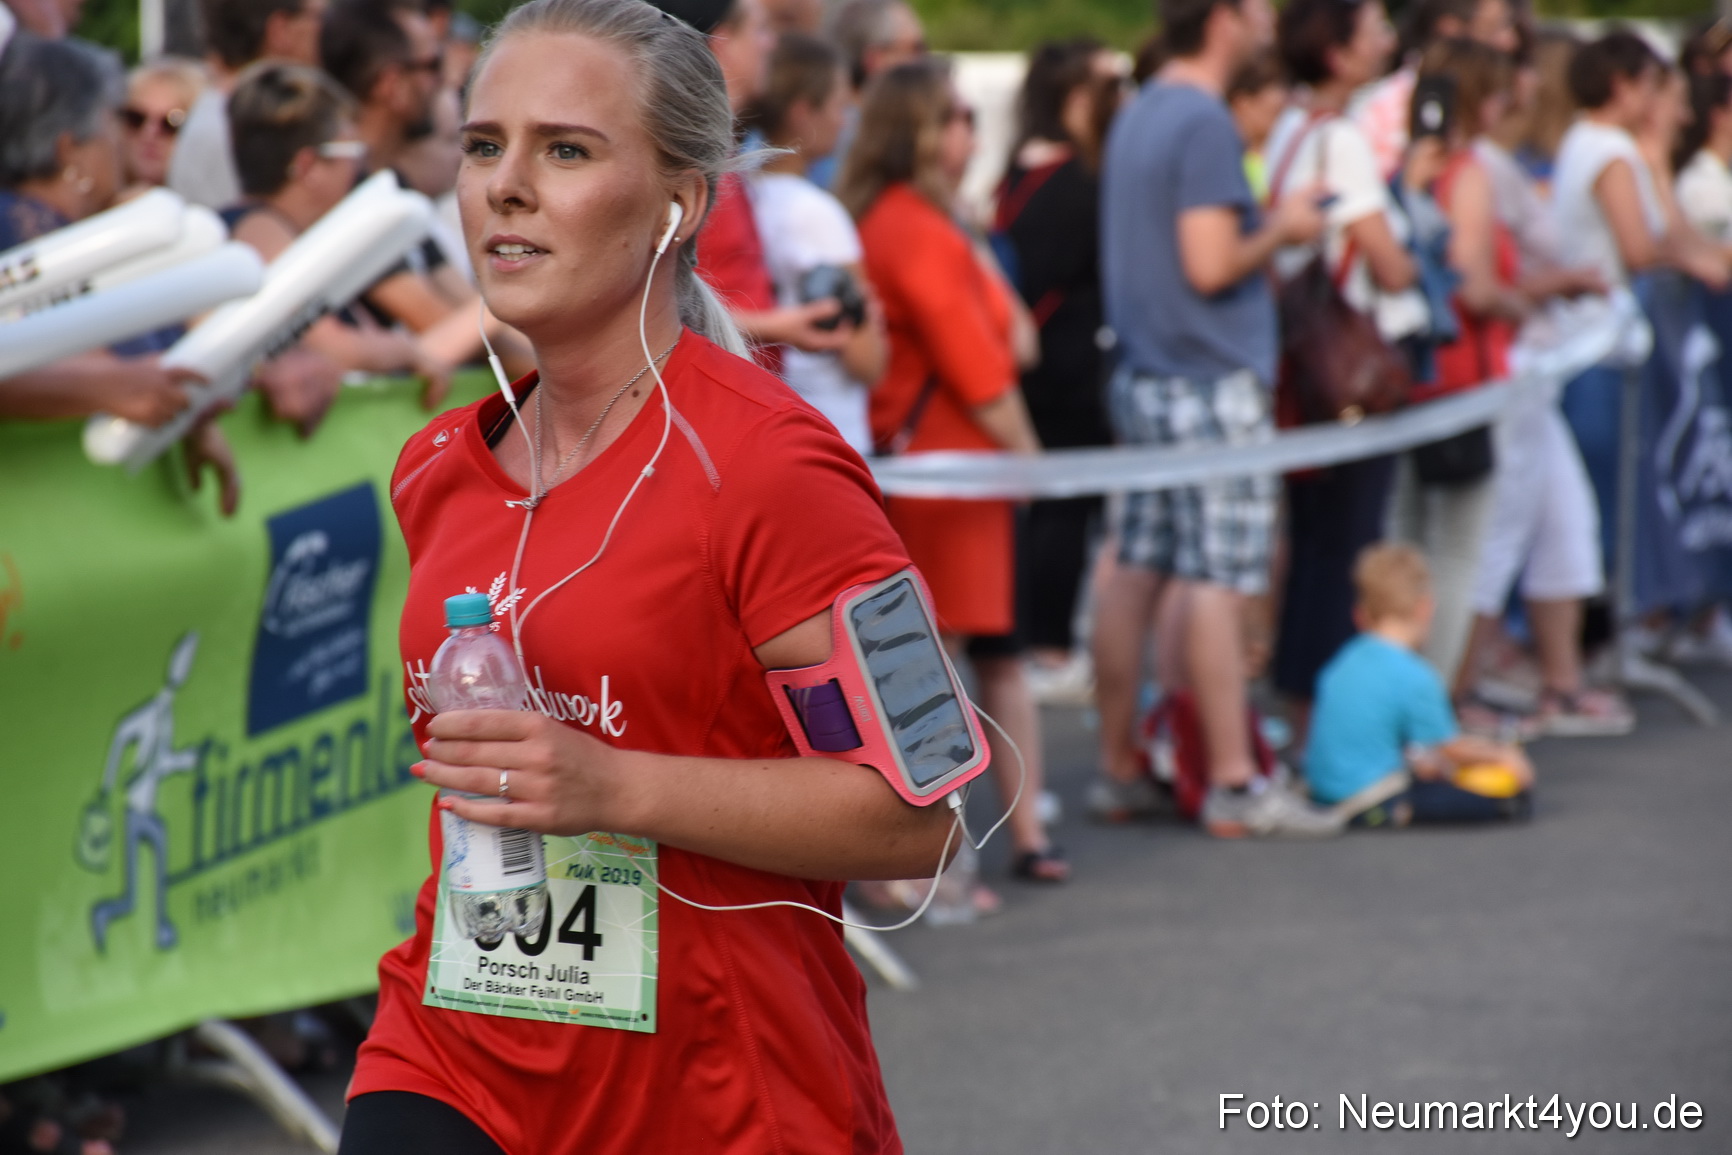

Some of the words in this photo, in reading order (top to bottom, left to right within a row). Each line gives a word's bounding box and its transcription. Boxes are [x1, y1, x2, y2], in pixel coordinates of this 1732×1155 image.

[601, 866, 642, 886] 2019
[478, 956, 540, 979] Porsch
[546, 963, 591, 984] Julia
[463, 977, 483, 991] Der
[485, 980, 527, 997] Bäcker
[530, 985, 561, 999] Feihl
[564, 989, 605, 1004] GmbH
